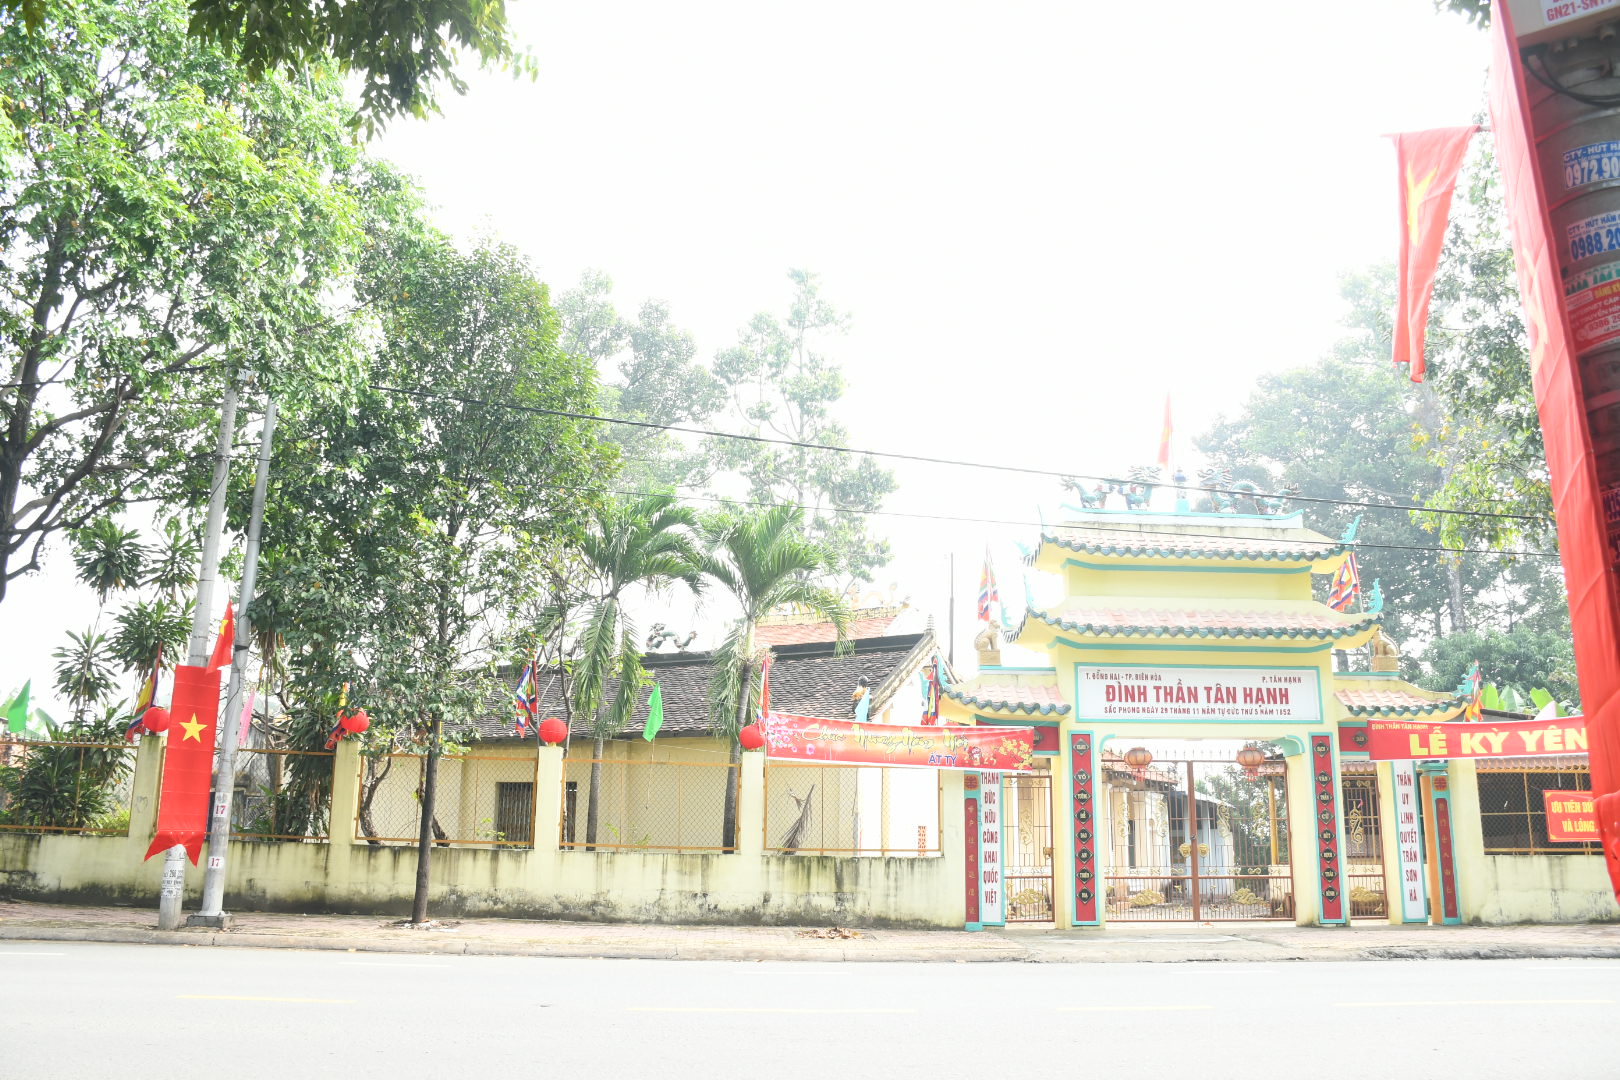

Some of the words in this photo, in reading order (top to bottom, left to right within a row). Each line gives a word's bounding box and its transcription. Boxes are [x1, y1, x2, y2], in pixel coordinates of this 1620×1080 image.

[1105, 681, 1148, 702] ĐÌNH
[1153, 678, 1198, 703] THẦN
[1204, 683, 1237, 704] TÂN
[1243, 687, 1289, 707] HẠNH
[1142, 706, 1158, 714] NGÀY
[1170, 706, 1190, 714] THÁNG
[802, 723, 846, 742] Chúc
[943, 728, 968, 753] Mới
[1409, 726, 1447, 756] LỄ
[1460, 728, 1510, 754] KỲ
[1518, 725, 1588, 752] YÊN
[216, 805, 226, 814] 17
[1400, 812, 1414, 824] LINH
[211, 858, 220, 867] 17
[984, 851, 997, 863] KHAI
[983, 866, 998, 885] QUỐC
[1406, 868, 1417, 882] SƠN
[985, 888, 997, 906] VIỆT
